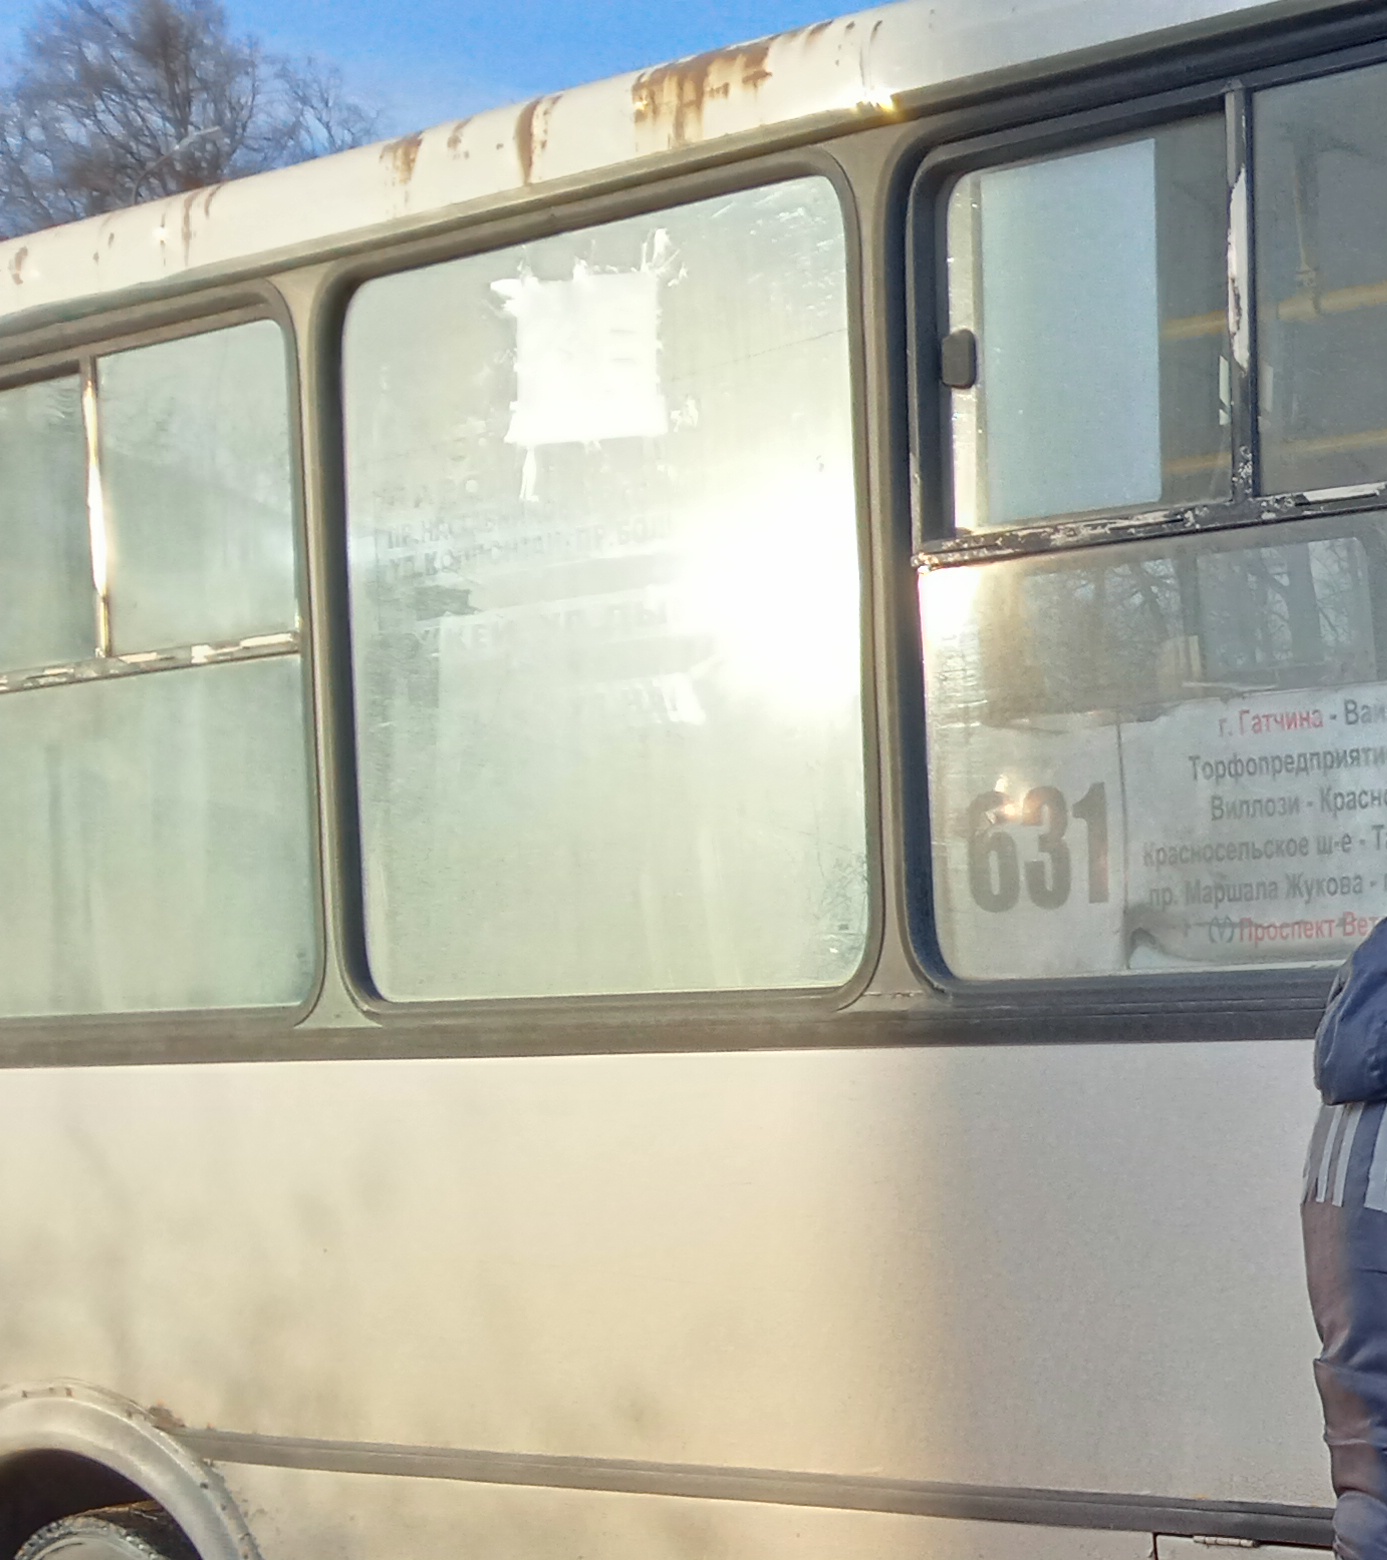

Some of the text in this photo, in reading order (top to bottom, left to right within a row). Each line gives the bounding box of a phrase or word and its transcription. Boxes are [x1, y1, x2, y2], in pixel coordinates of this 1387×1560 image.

[1238, 707, 1324, 735] Гатчина
[1211, 794, 1302, 822] Виллози
[968, 782, 1110, 913] 631
[1143, 835, 1310, 868] Красносельское
[1185, 878, 1279, 909] Маршала
[1286, 870, 1363, 905] Жукова
[1239, 914, 1337, 947] Проспект
